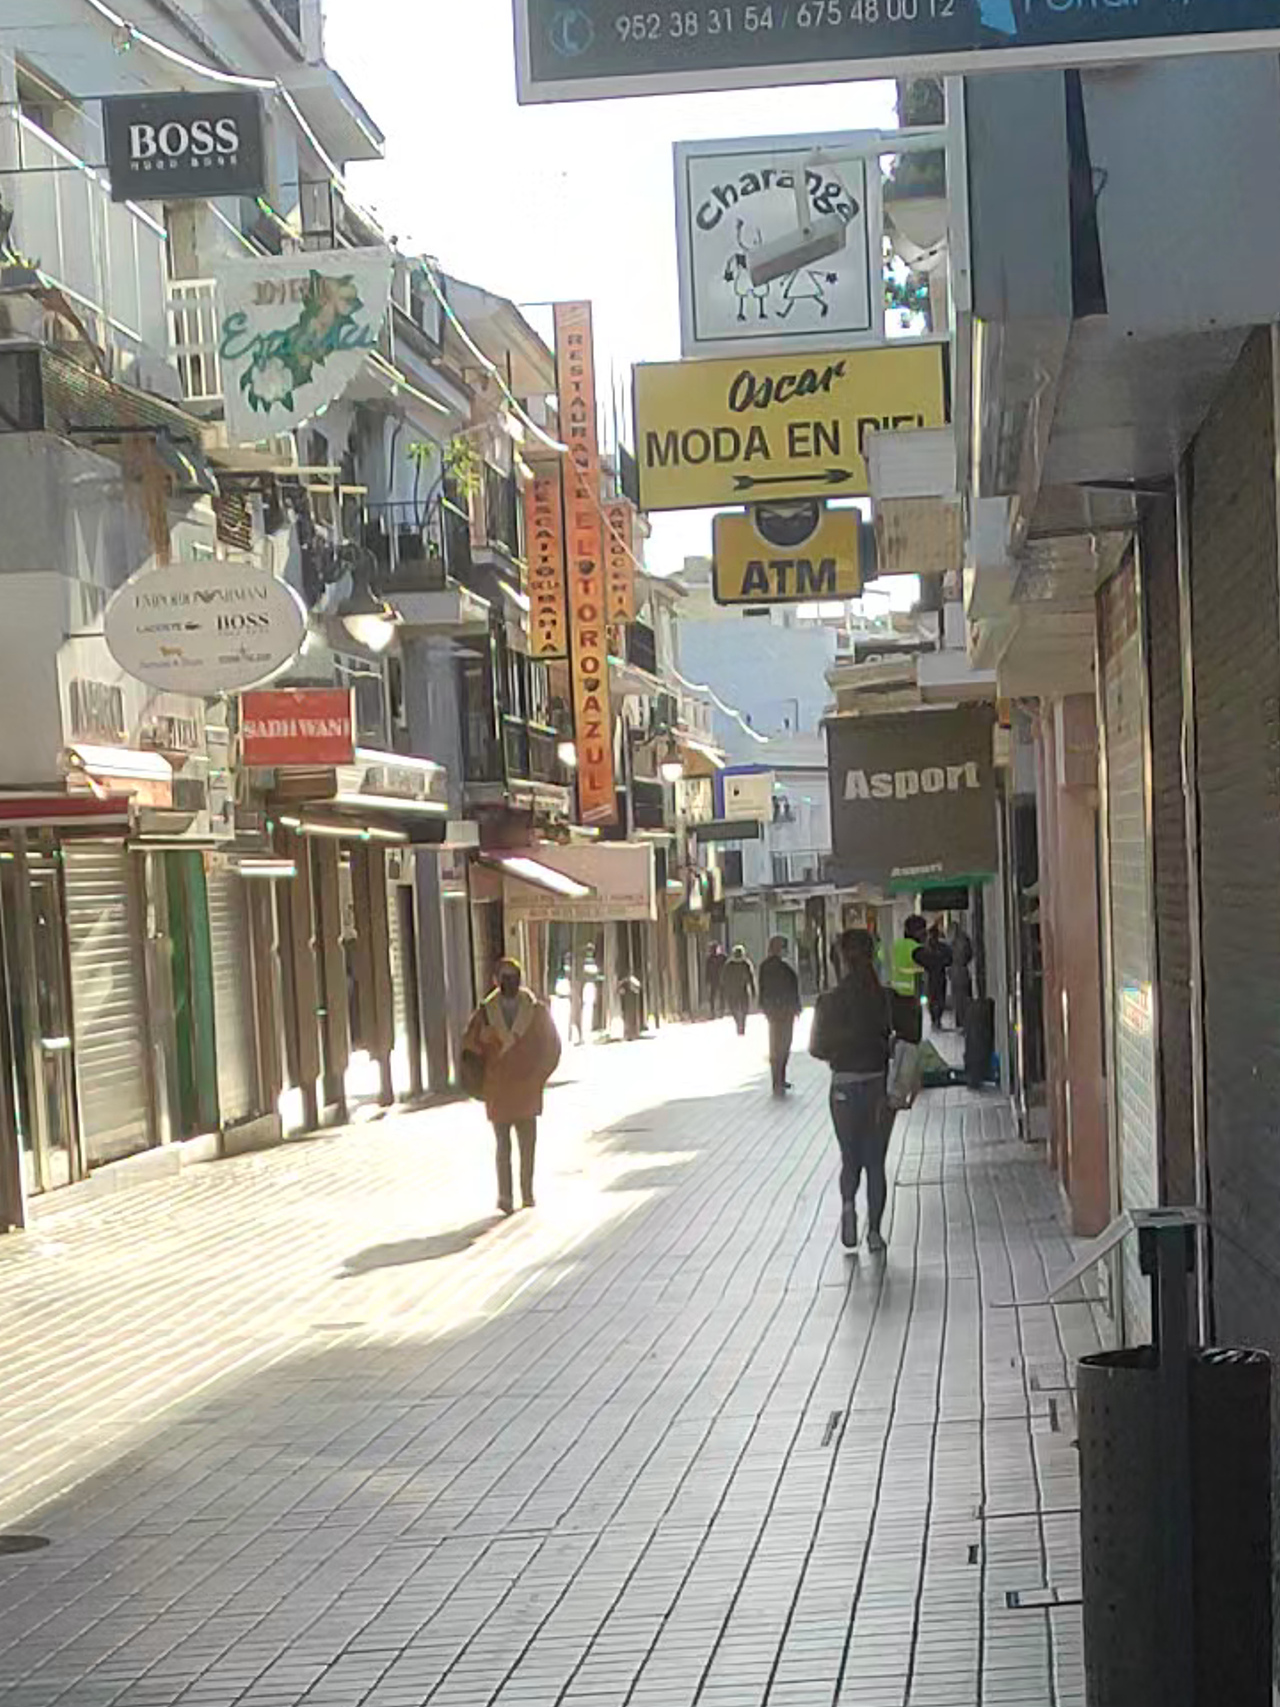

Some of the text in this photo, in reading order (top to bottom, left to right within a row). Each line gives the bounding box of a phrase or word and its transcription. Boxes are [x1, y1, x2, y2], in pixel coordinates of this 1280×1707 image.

[616, 14, 661, 42] 952
[669, 10, 698, 38] 38
[707, 7, 733, 34] 31
[744, 5, 773, 32] 54
[797, 0, 842, 29] 675
[129, 118, 239, 159] BOSS
[728, 358, 847, 413] Oscar
[568, 333, 591, 499] RESTAURANTE
[645, 426, 770, 468] MODA
[788, 422, 841, 459] EN
[740, 557, 837, 596] ATM
[575, 511, 604, 791] EL TORO AZUL
[844, 761, 981, 801] Asport
